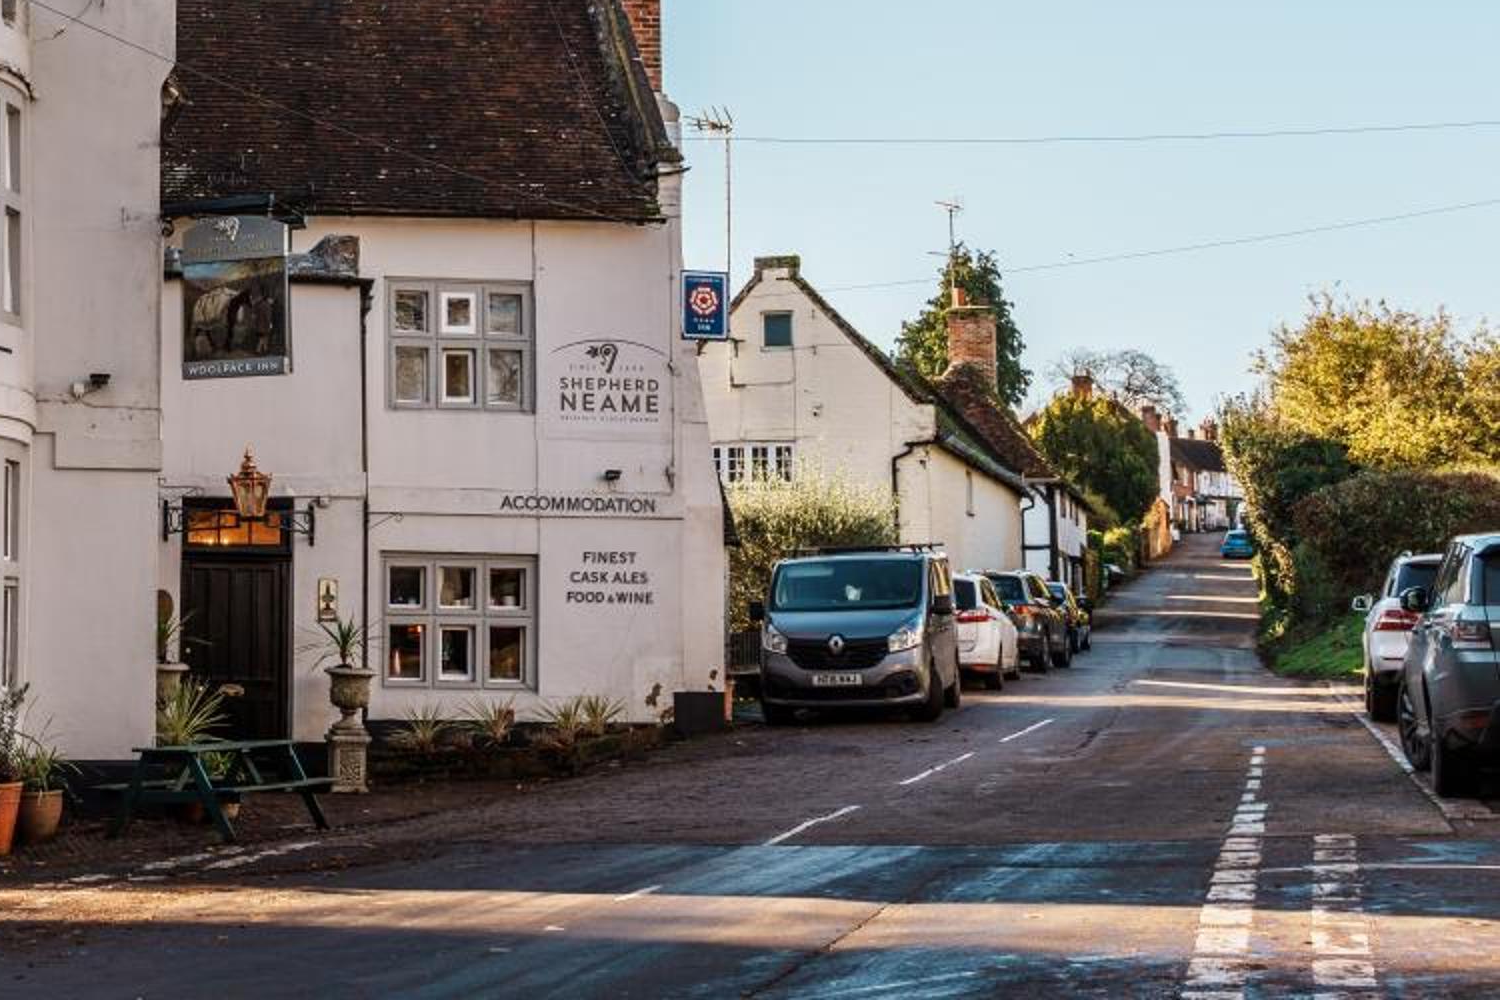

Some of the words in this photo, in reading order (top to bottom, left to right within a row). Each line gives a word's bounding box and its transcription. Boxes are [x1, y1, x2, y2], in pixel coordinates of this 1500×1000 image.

[560, 377, 659, 392] SHEPHERD
[560, 392, 659, 413] NEAME
[500, 494, 656, 513] ACCOMMODATION
[582, 551, 637, 565] FINEST
[569, 571, 609, 584] CASK
[611, 571, 649, 585] ALES
[566, 591, 605, 604] FOOD
[615, 592, 654, 605] WINE
